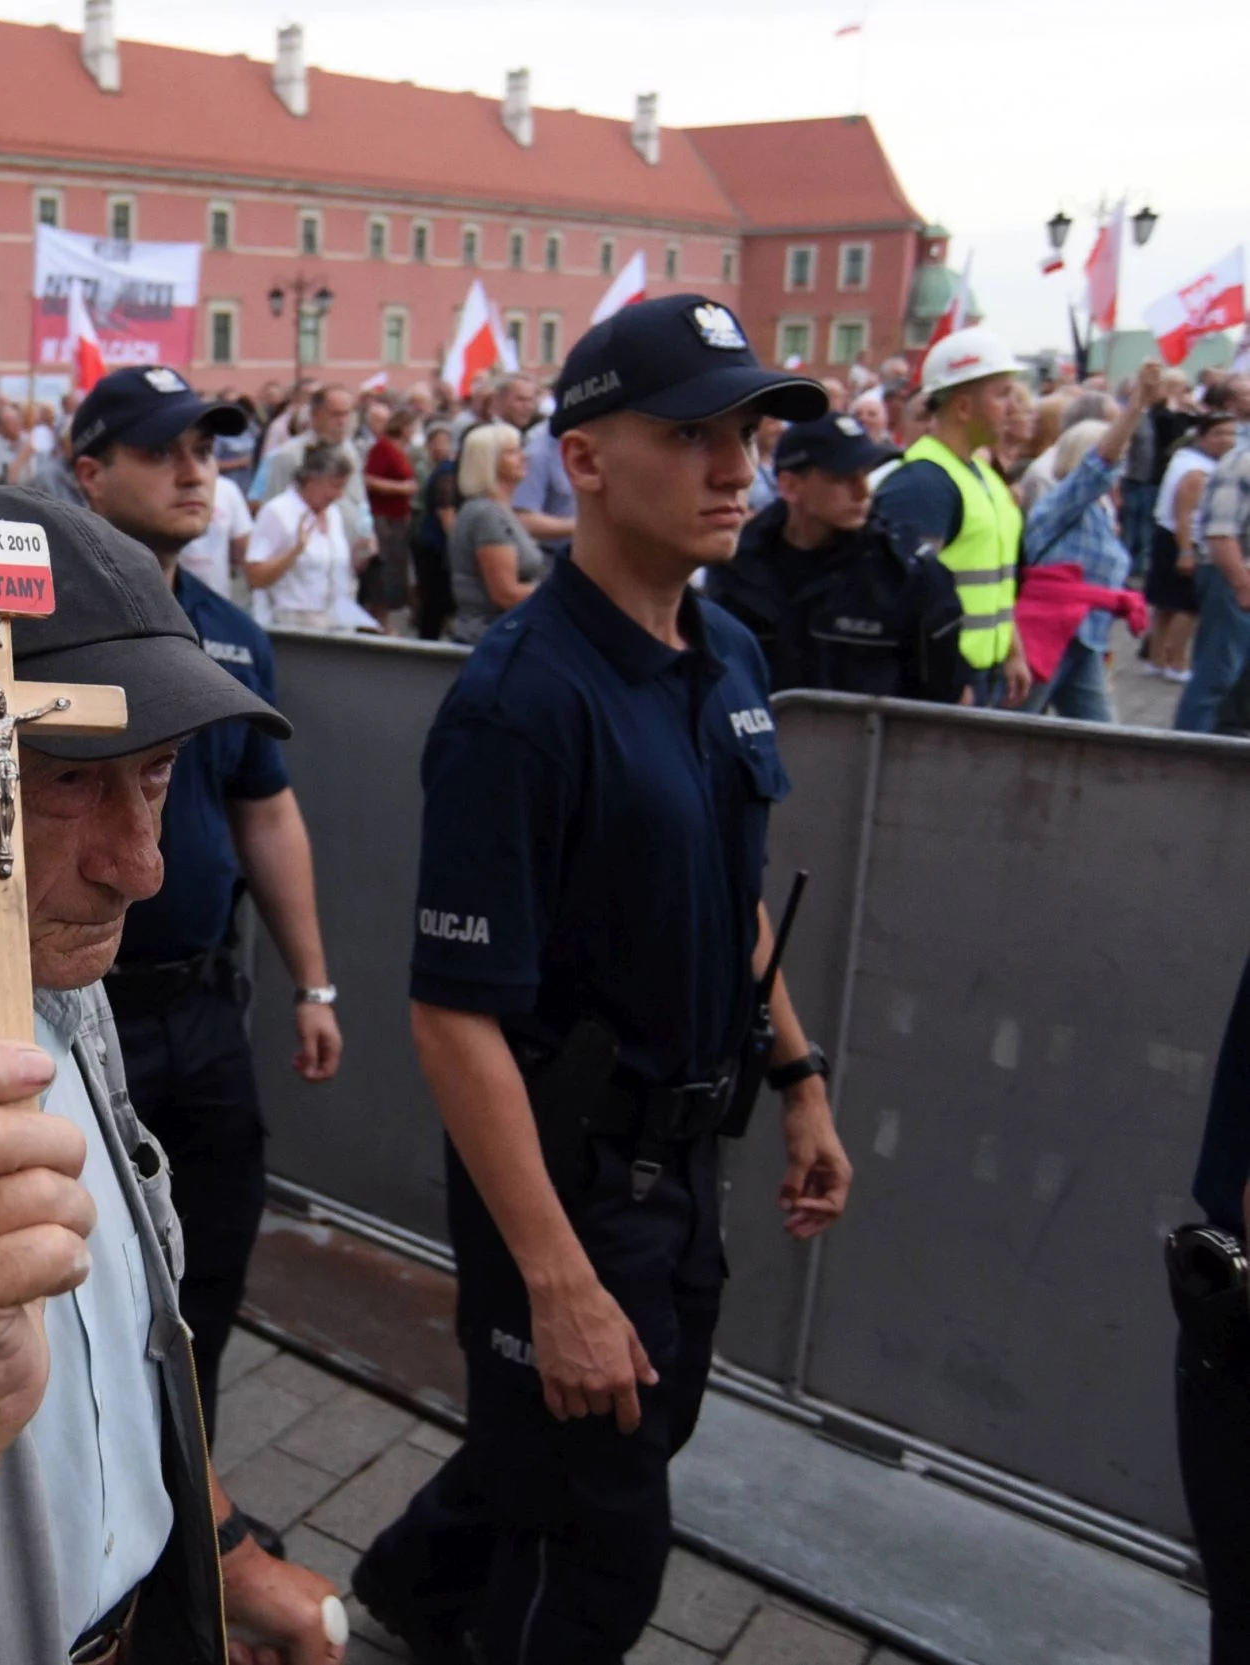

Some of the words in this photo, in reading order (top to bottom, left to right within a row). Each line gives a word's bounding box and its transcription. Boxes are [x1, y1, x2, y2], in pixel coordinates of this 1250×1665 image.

[7, 535, 41, 552] 2010
[419, 907, 490, 944] OLICJA
[491, 1327, 533, 1367] POLI
